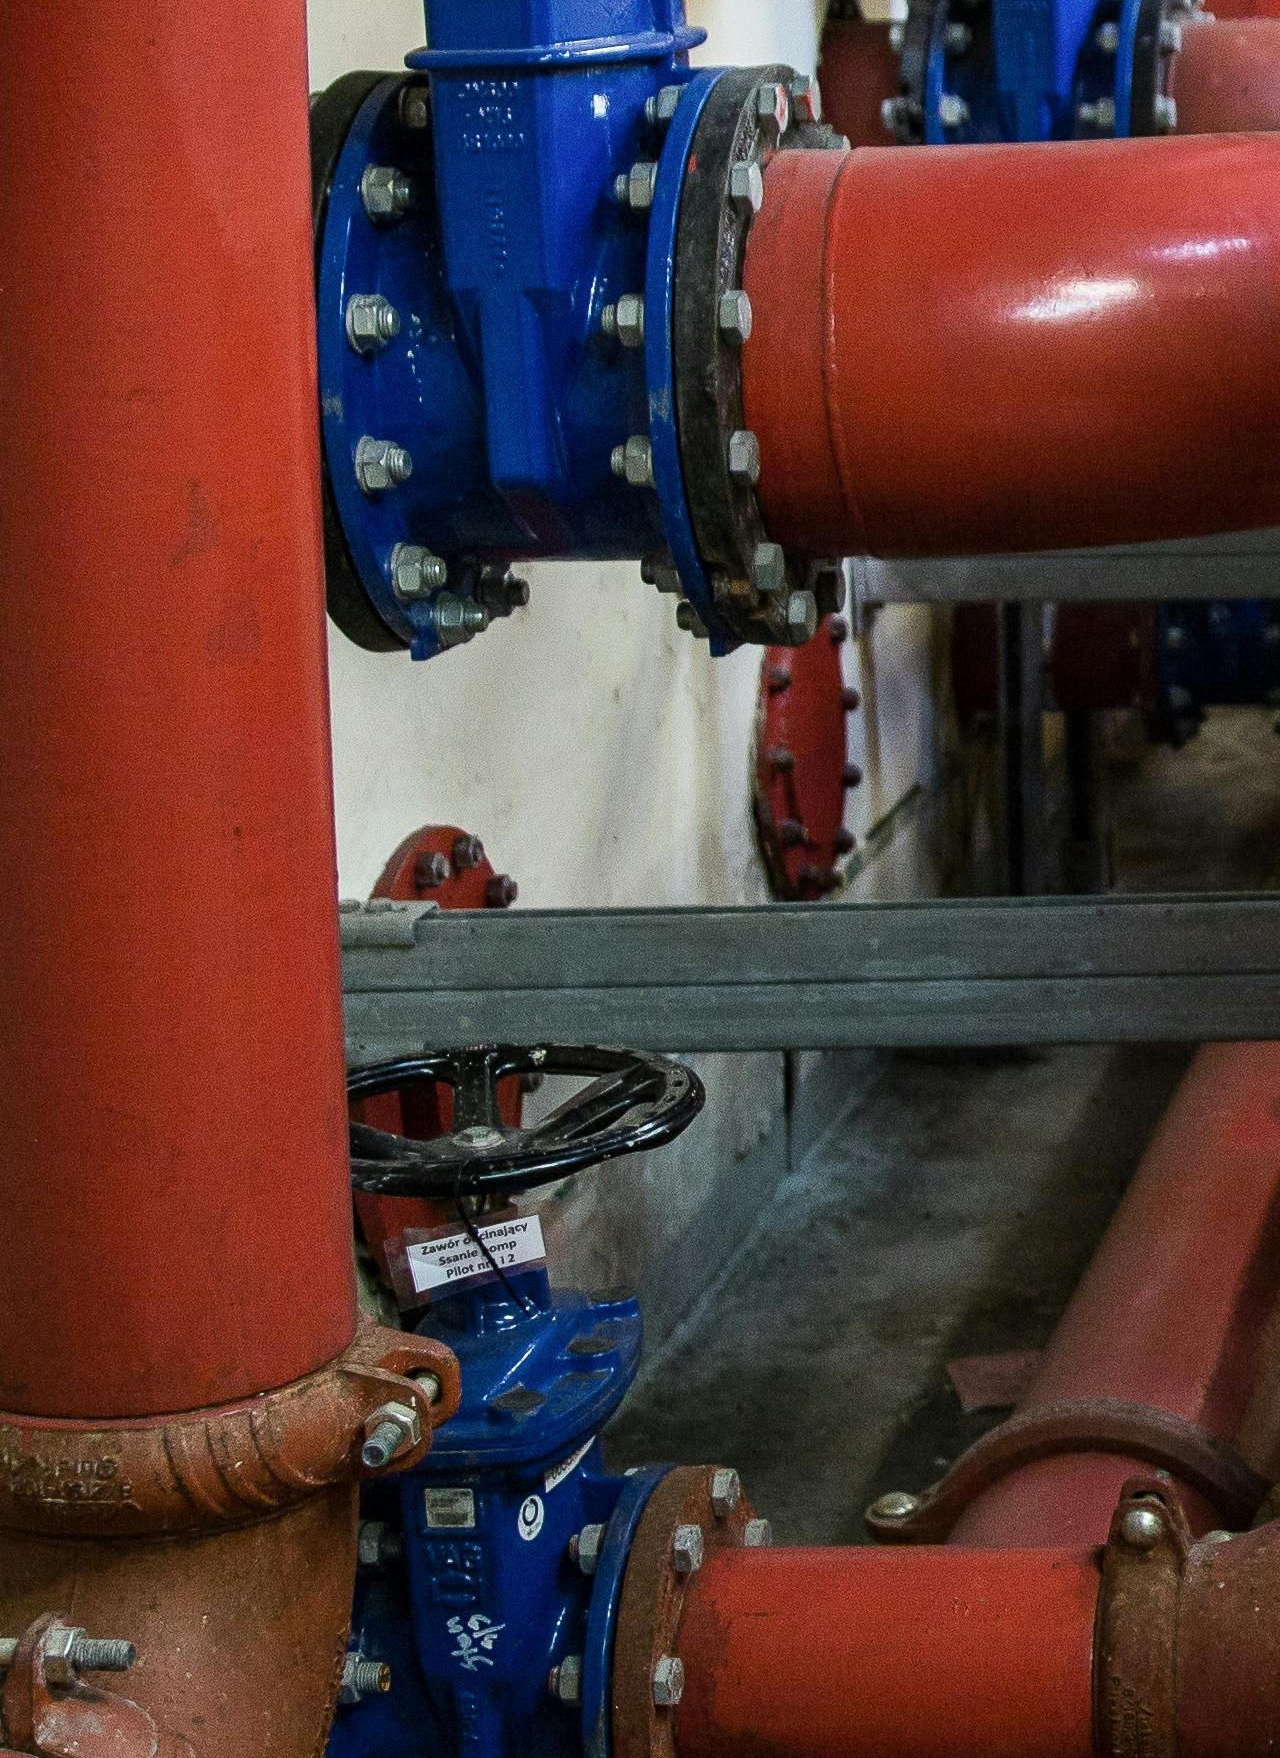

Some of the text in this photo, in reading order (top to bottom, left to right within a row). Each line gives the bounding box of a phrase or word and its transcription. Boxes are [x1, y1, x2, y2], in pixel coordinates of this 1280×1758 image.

[421, 1222, 528, 1256] Zawór ocinający
[438, 1240, 517, 1267] Ssanie omp
[446, 1263, 474, 1279] Pilot
[508, 1253, 516, 1263] 2
